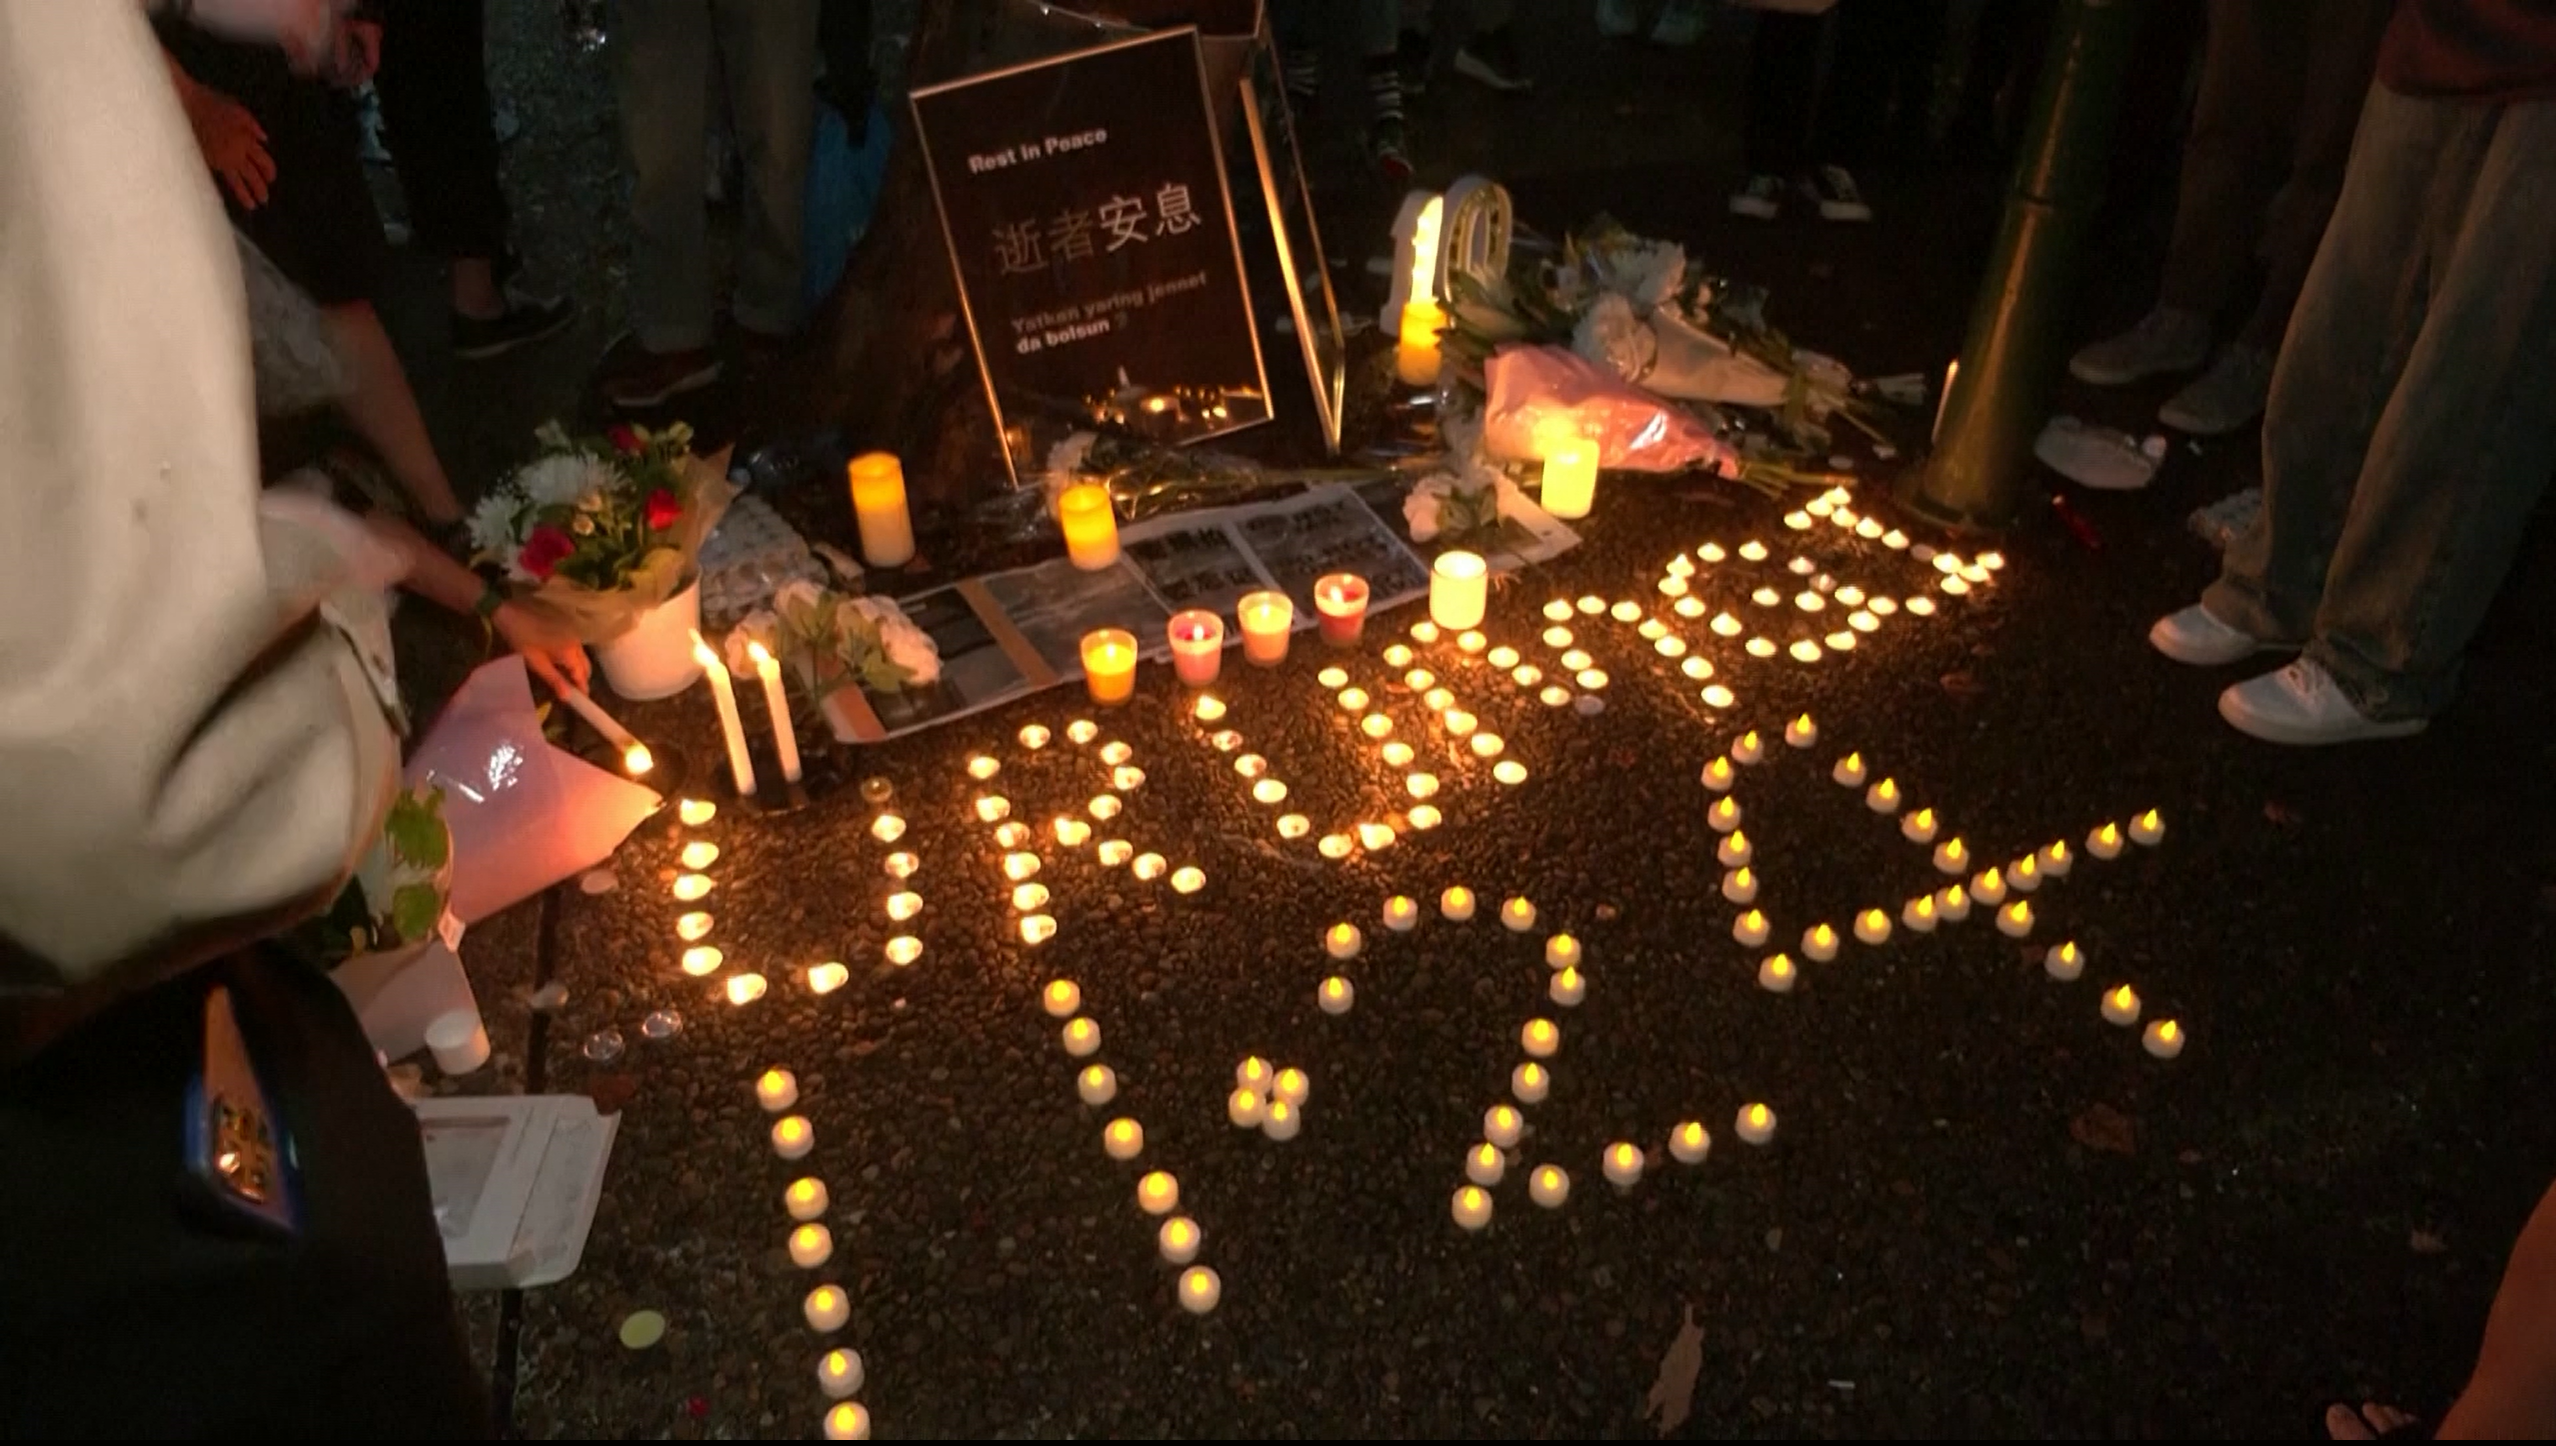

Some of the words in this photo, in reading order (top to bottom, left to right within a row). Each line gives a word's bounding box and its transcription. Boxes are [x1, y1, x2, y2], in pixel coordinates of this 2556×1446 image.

[968, 149, 1017, 175] Rest
[1044, 127, 1109, 156] Peace
[992, 181, 1202, 276] 逝者安息
[1016, 335, 1042, 355] da
[1045, 318, 1111, 348] bolsun
